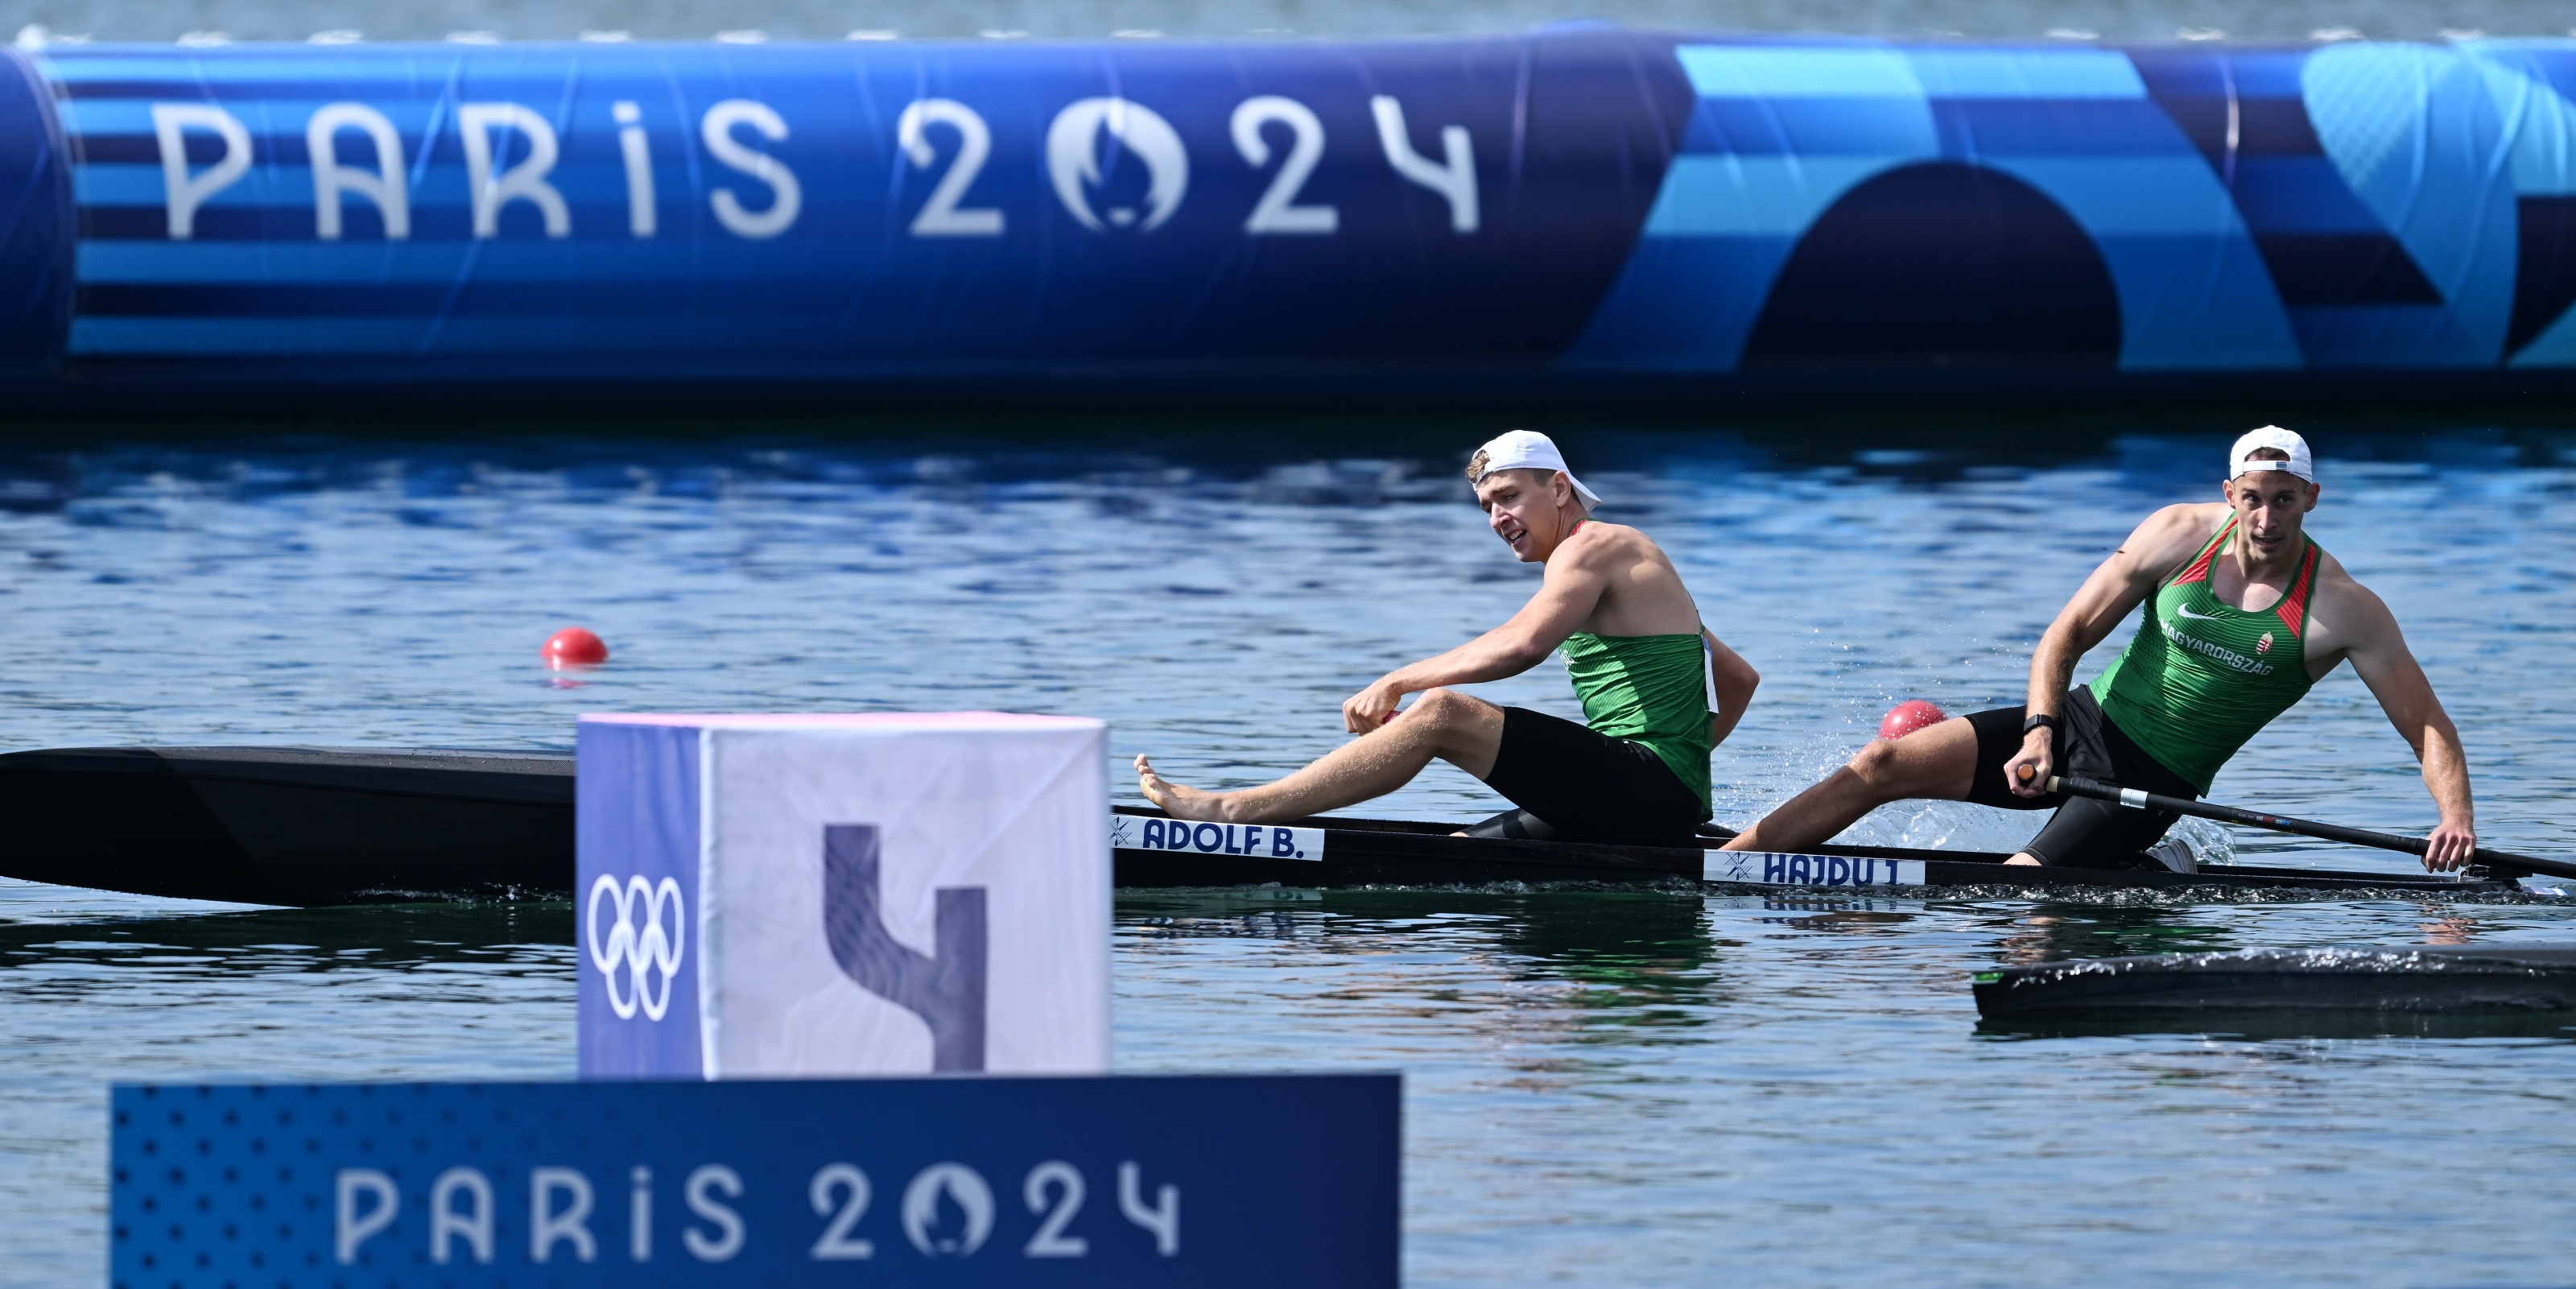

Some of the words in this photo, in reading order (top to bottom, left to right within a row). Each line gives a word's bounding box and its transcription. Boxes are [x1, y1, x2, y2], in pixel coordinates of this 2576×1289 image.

[897, 94, 1479, 233] 2024
[2160, 618, 2274, 675] MAGYARORSZÁG
[1142, 819, 1262, 855] ADOLF
[1272, 827, 1304, 859] B.
[1763, 853, 1875, 886] HAJDU
[1885, 859, 1905, 886] J
[823, 824, 988, 1072] 4
[811, 1161, 1179, 1259] 2024
